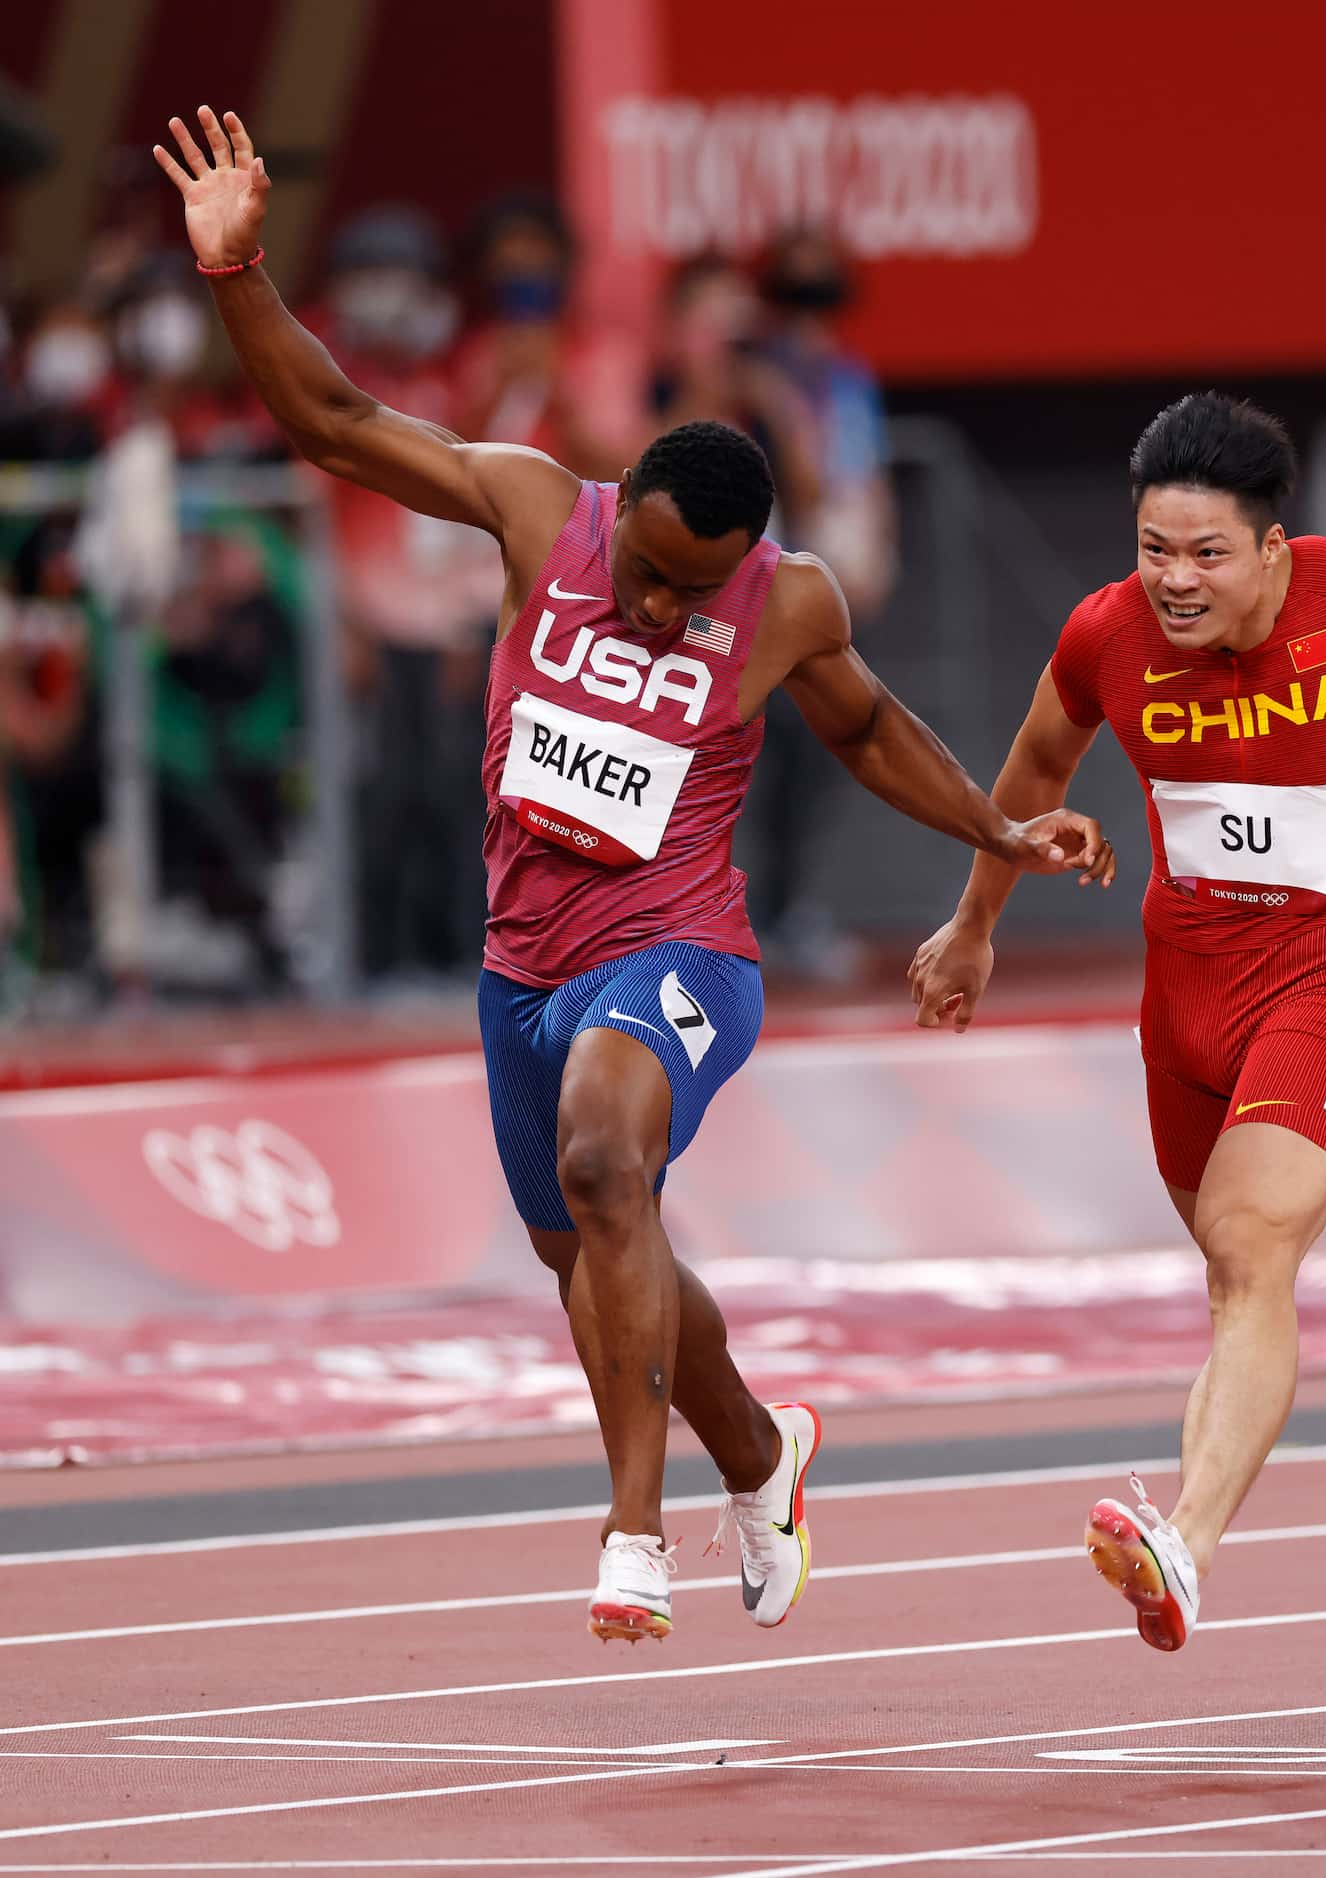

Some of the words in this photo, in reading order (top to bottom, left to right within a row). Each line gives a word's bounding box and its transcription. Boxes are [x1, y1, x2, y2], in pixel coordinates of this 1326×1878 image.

[529, 608, 713, 726] USA
[528, 721, 652, 807] BAKER
[527, 810, 549, 828] TOKYO
[548, 822, 570, 837] 2020
[1220, 814, 1272, 854] SU
[1209, 888, 1237, 901] TOKYO
[1237, 892, 1259, 903] 2020
[673, 987, 705, 1030] 7
